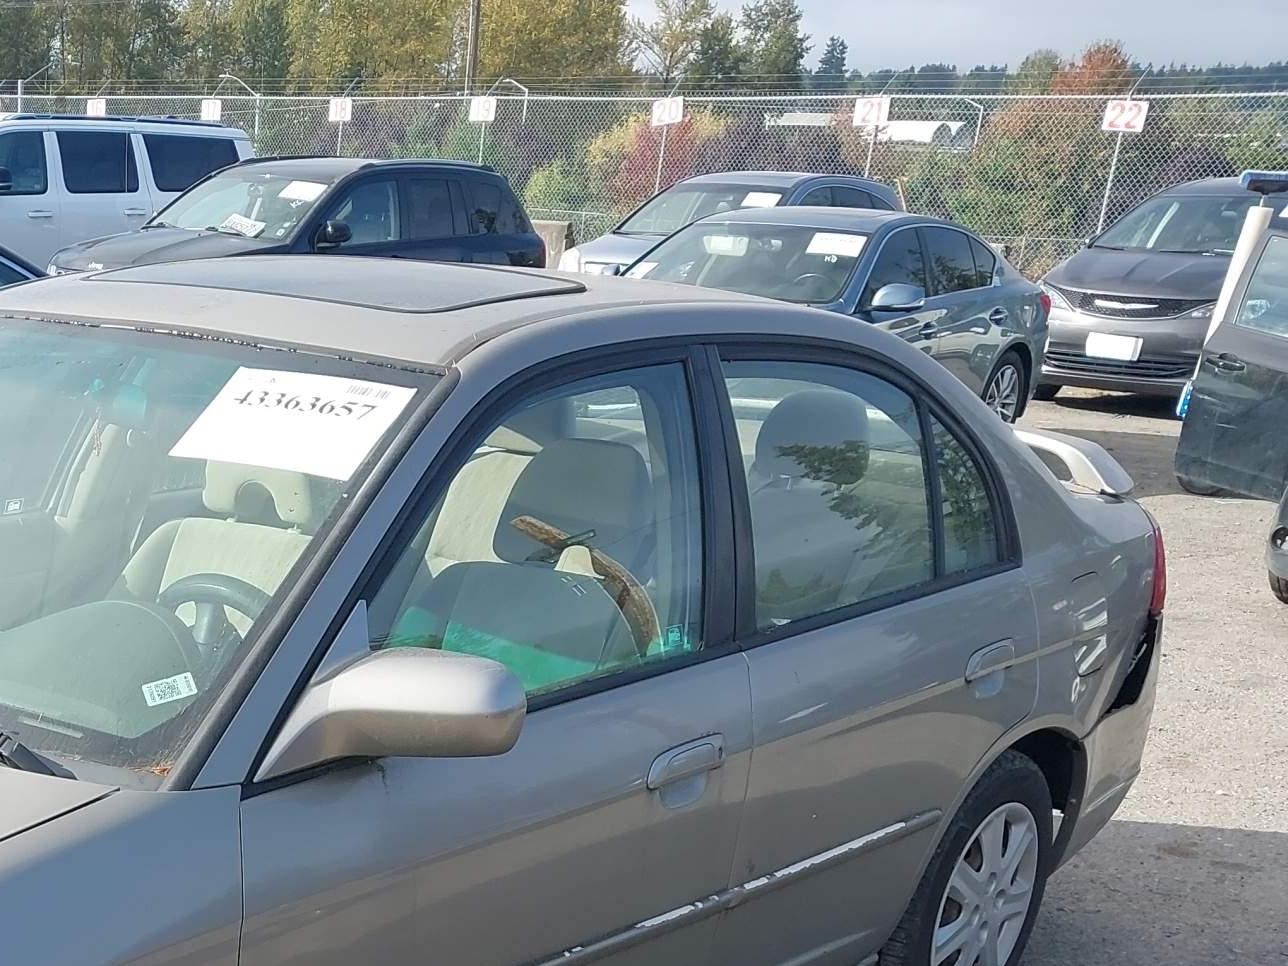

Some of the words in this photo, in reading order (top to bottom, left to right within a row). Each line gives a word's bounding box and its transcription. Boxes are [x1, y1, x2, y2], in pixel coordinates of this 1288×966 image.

[206, 101, 217, 117] 17
[334, 101, 347, 119] 18
[476, 100, 490, 119] 19
[656, 100, 679, 123] 20
[861, 100, 883, 123] 21
[1108, 102, 1142, 128] 22
[233, 389, 378, 420] 43363657
